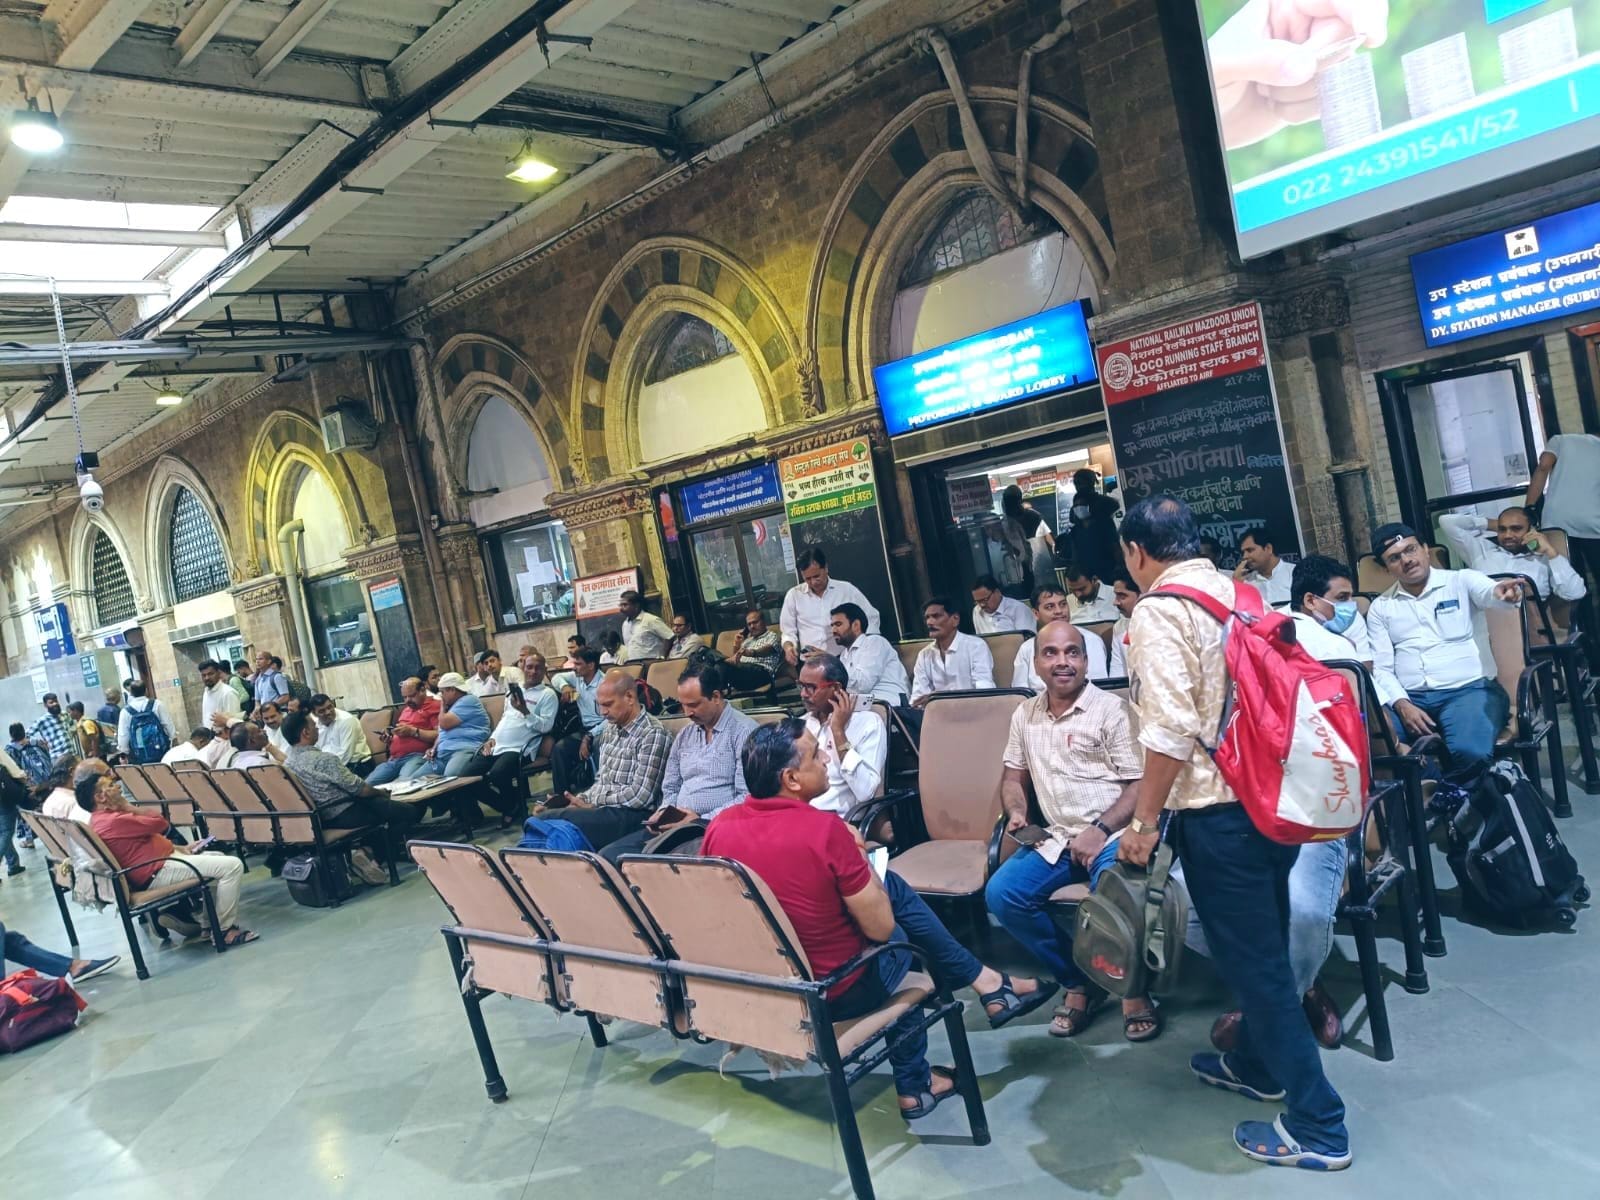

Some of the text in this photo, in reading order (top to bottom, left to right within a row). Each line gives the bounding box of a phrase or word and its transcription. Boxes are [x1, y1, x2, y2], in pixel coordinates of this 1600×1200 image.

[1283, 108, 1519, 205] 022 24391541/52
[1130, 307, 1256, 351] NATIONAL RAILWAY MAZDOOR UNION
[1431, 287, 1600, 338] DY. STATION MANAGER (SUBU
[1133, 359, 1164, 374] LOCO
[1165, 349, 1199, 366] RUNNING
[1201, 341, 1224, 356] STAFF
[1226, 331, 1259, 349] BRANCH
[1026, 374, 1066, 393] LOBBY
[1189, 373, 1198, 383] TO
